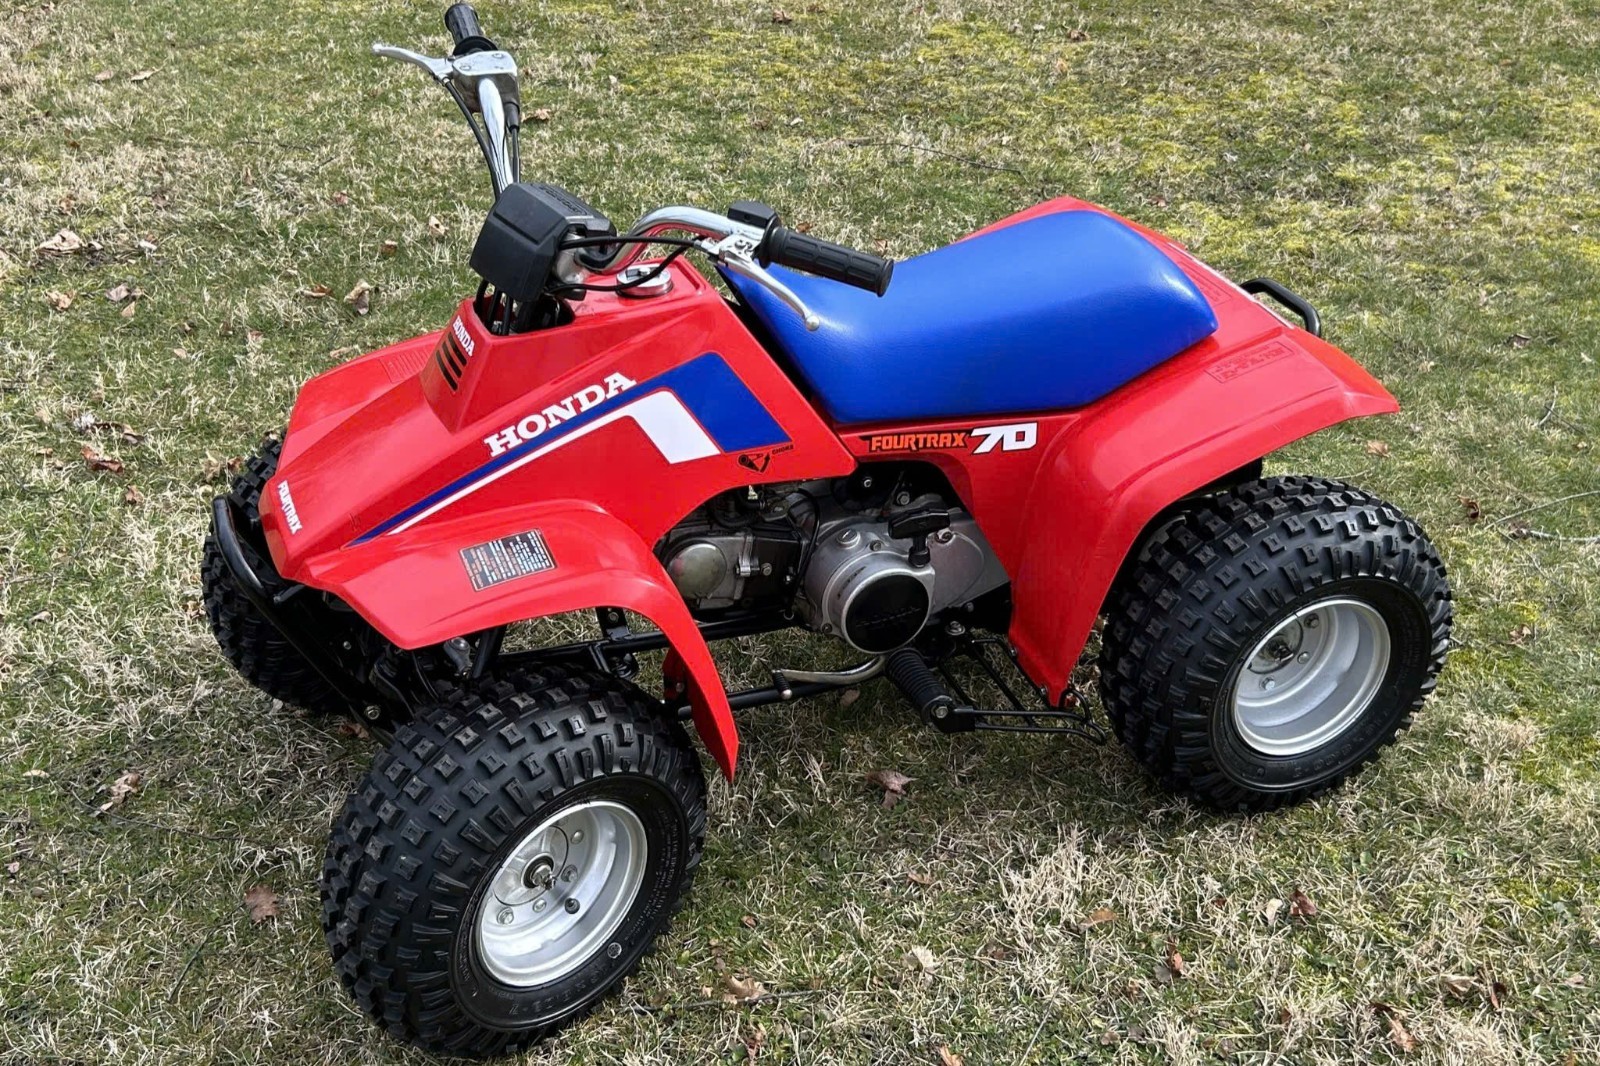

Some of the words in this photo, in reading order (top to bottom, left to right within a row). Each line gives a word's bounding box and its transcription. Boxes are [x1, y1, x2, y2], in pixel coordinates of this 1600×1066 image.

[453, 315, 475, 357] HONDA
[484, 372, 637, 457] HONDA
[870, 432, 966, 451] FOURTRAX
[970, 422, 1038, 454] 70
[277, 479, 303, 535] FOURTRAX
